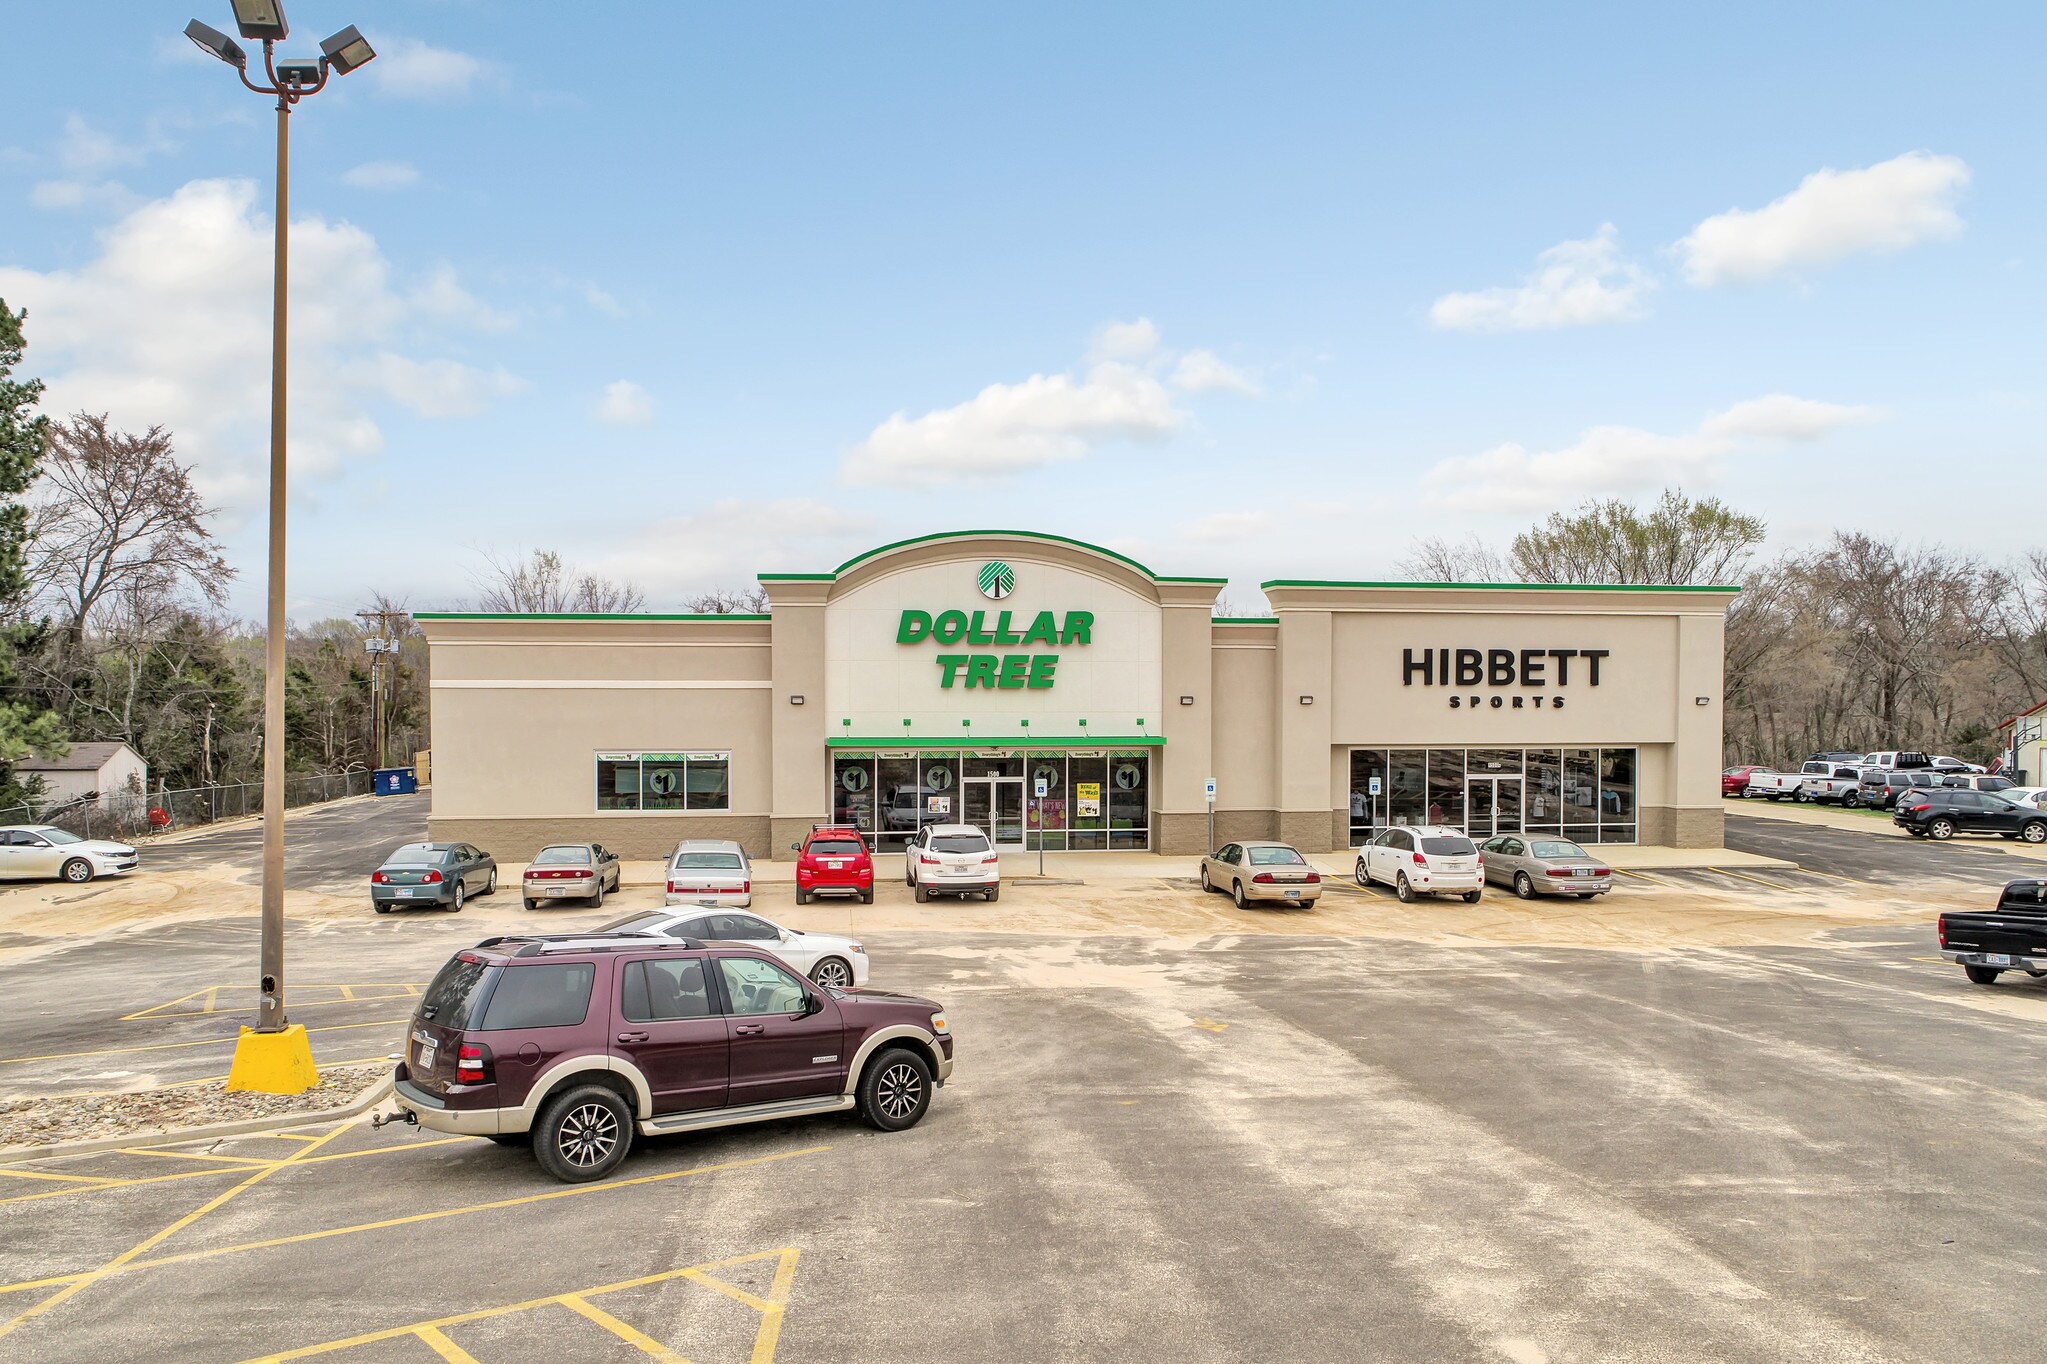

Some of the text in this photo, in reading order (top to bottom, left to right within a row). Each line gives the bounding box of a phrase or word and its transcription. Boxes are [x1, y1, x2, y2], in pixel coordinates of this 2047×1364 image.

[896, 609, 1095, 645] DOLLAR
[936, 654, 1060, 689] TREE
[1402, 648, 1610, 686] HIBBETT
[1449, 695, 1565, 708] SPORTS
[655, 774, 669, 793] $1
[848, 772, 862, 790] $1
[931, 771, 946, 789] $1
[1121, 771, 1134, 789] $1
